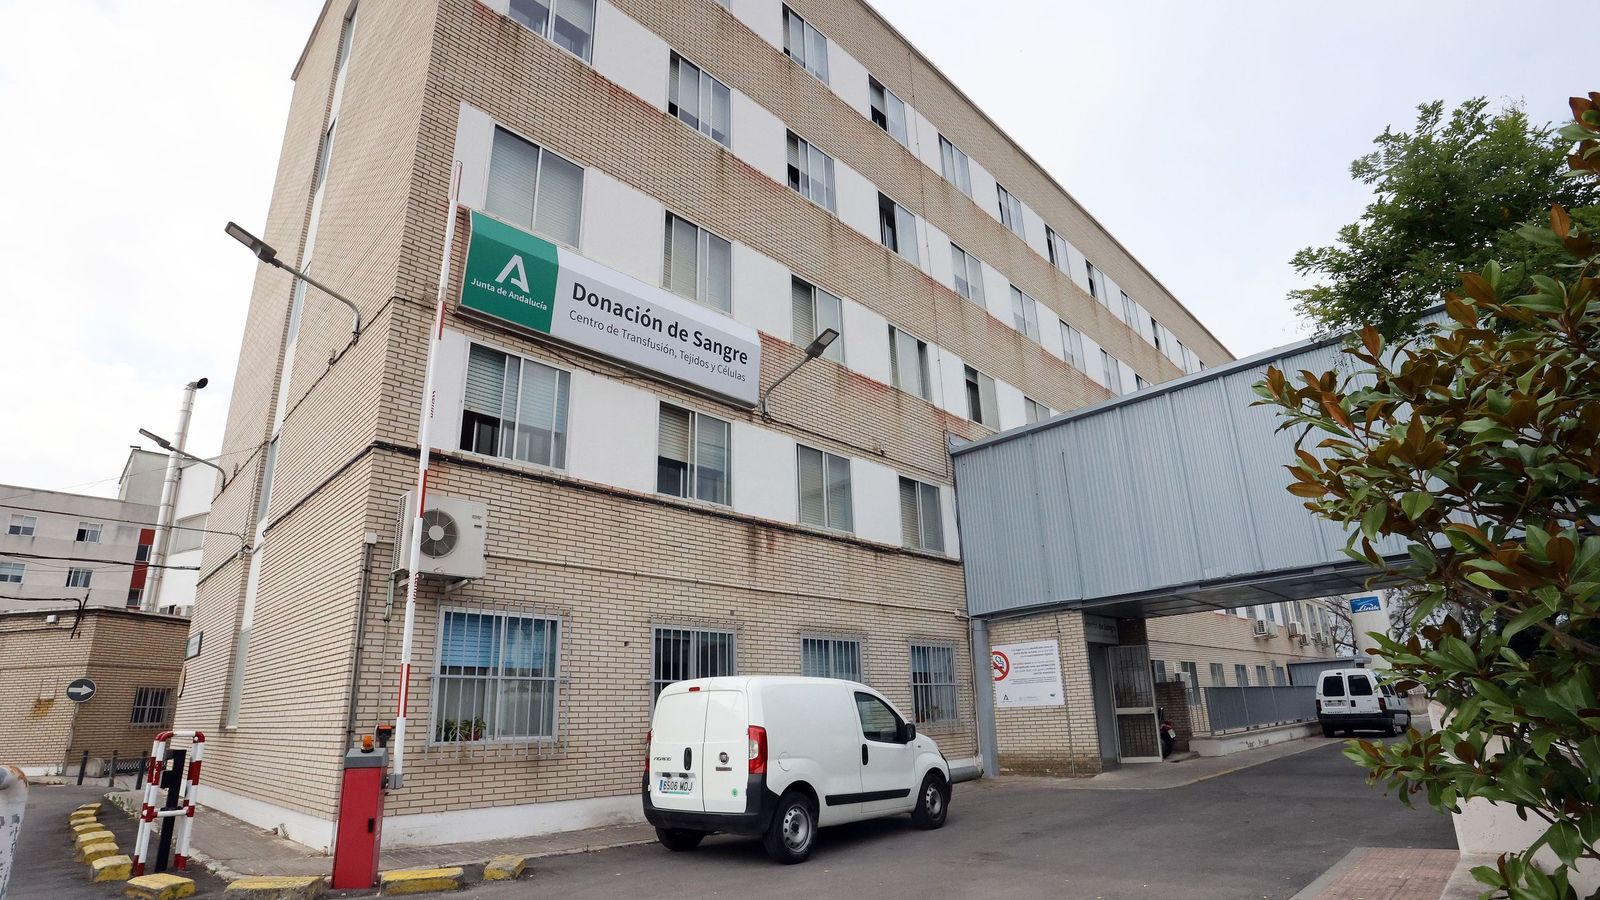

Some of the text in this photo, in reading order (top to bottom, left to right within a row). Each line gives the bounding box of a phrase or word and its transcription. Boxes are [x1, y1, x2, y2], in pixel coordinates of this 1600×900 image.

[470, 278, 548, 311] Junta de Andalucía
[569, 309, 746, 382] Centro de Transfusión, Tejidos y Células
[572, 282, 748, 365] Donación de Sangre
[1355, 603, 1380, 612] Linde
